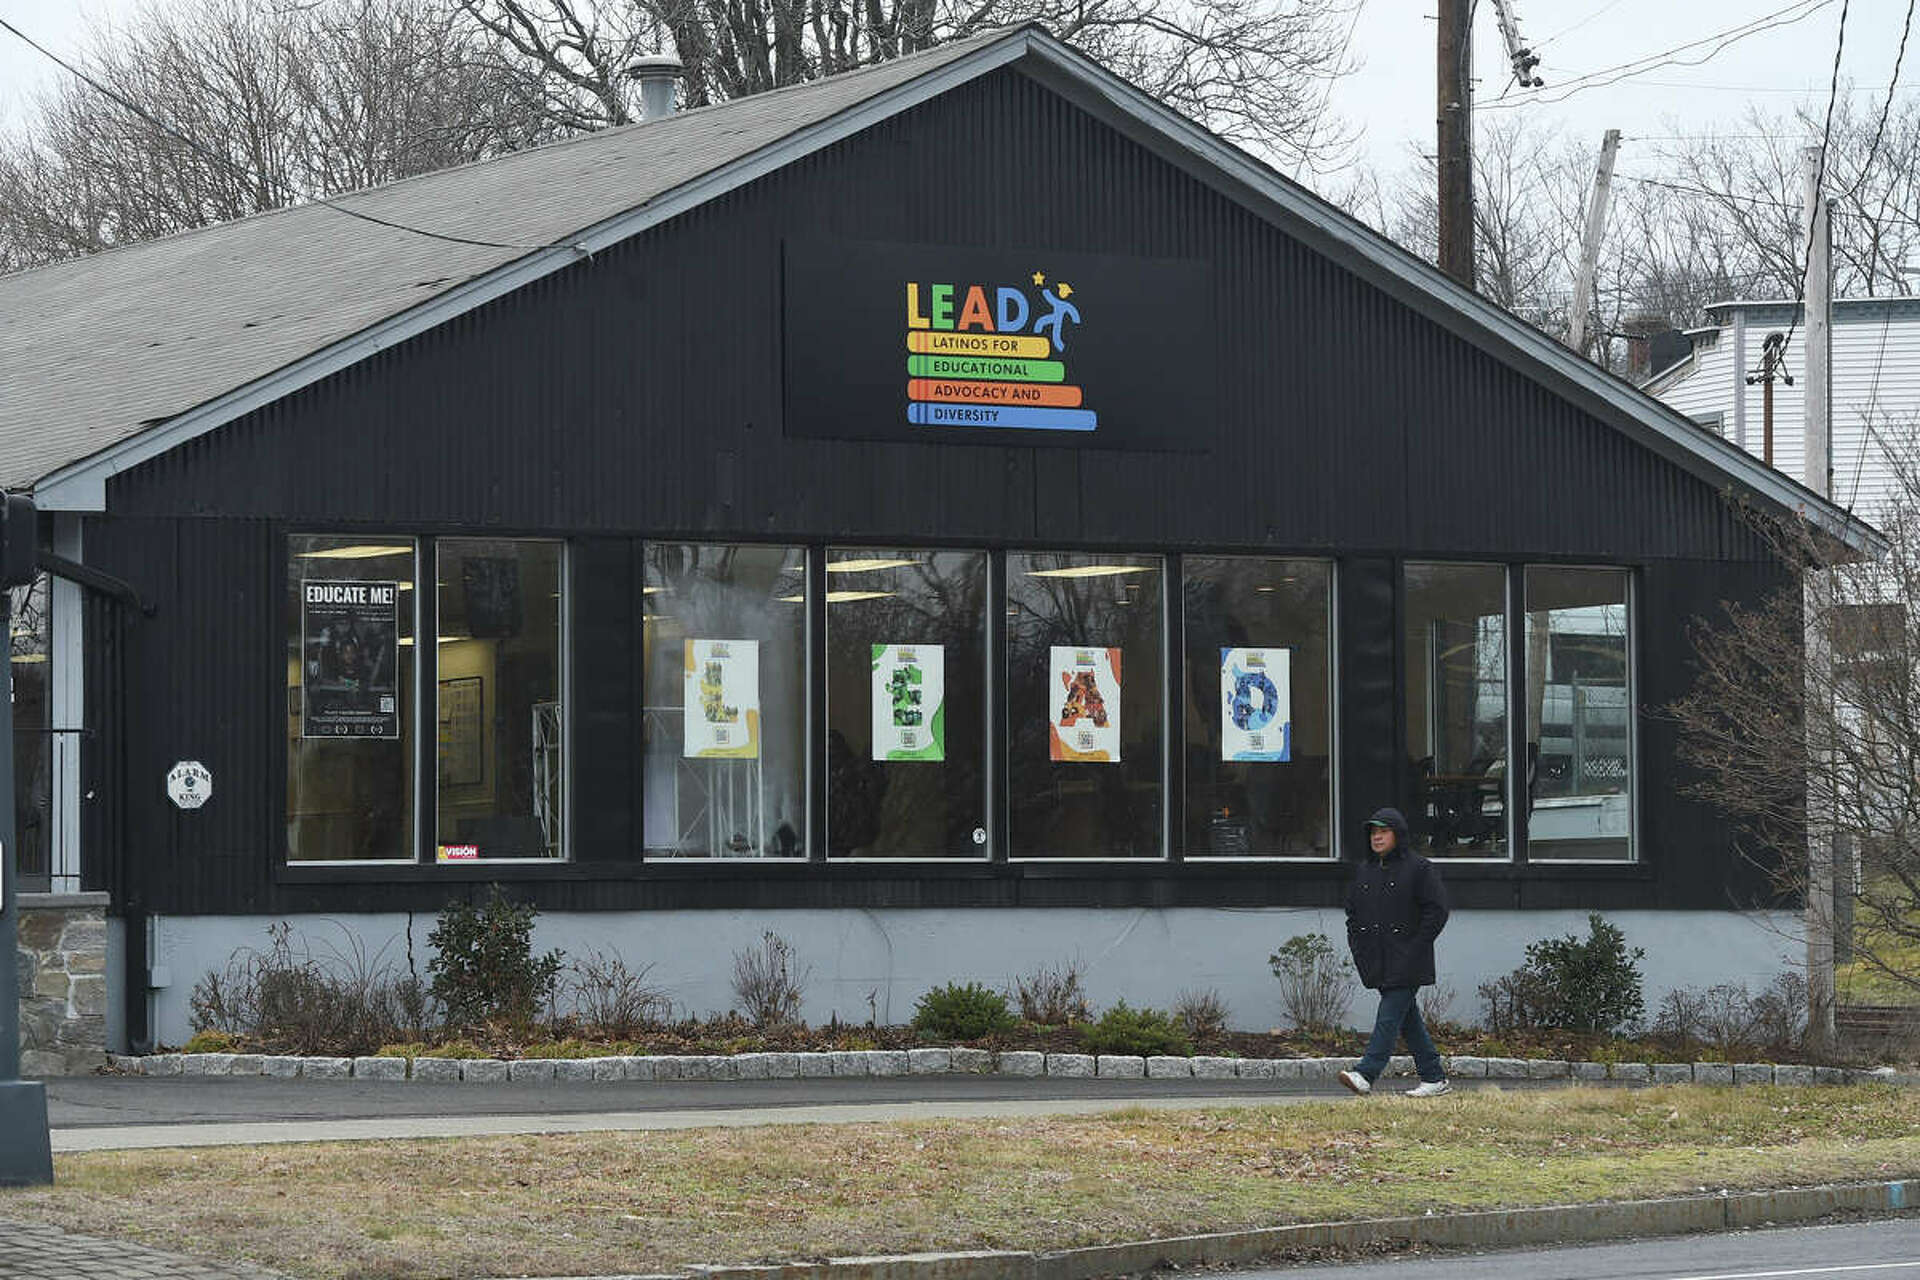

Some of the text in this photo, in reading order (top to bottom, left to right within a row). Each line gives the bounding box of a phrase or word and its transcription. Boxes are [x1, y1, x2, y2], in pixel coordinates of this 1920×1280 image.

[907, 282, 1030, 332] LEAD
[933, 336, 1019, 352] LATINOS FOR
[933, 360, 1029, 377] EDUCATIONAL
[934, 384, 1042, 401] ADVOCACY AND
[934, 407, 1000, 422] DIVERSITY
[306, 585, 394, 604] EDUCATE ME!
[170, 767, 210, 783] ALARM
